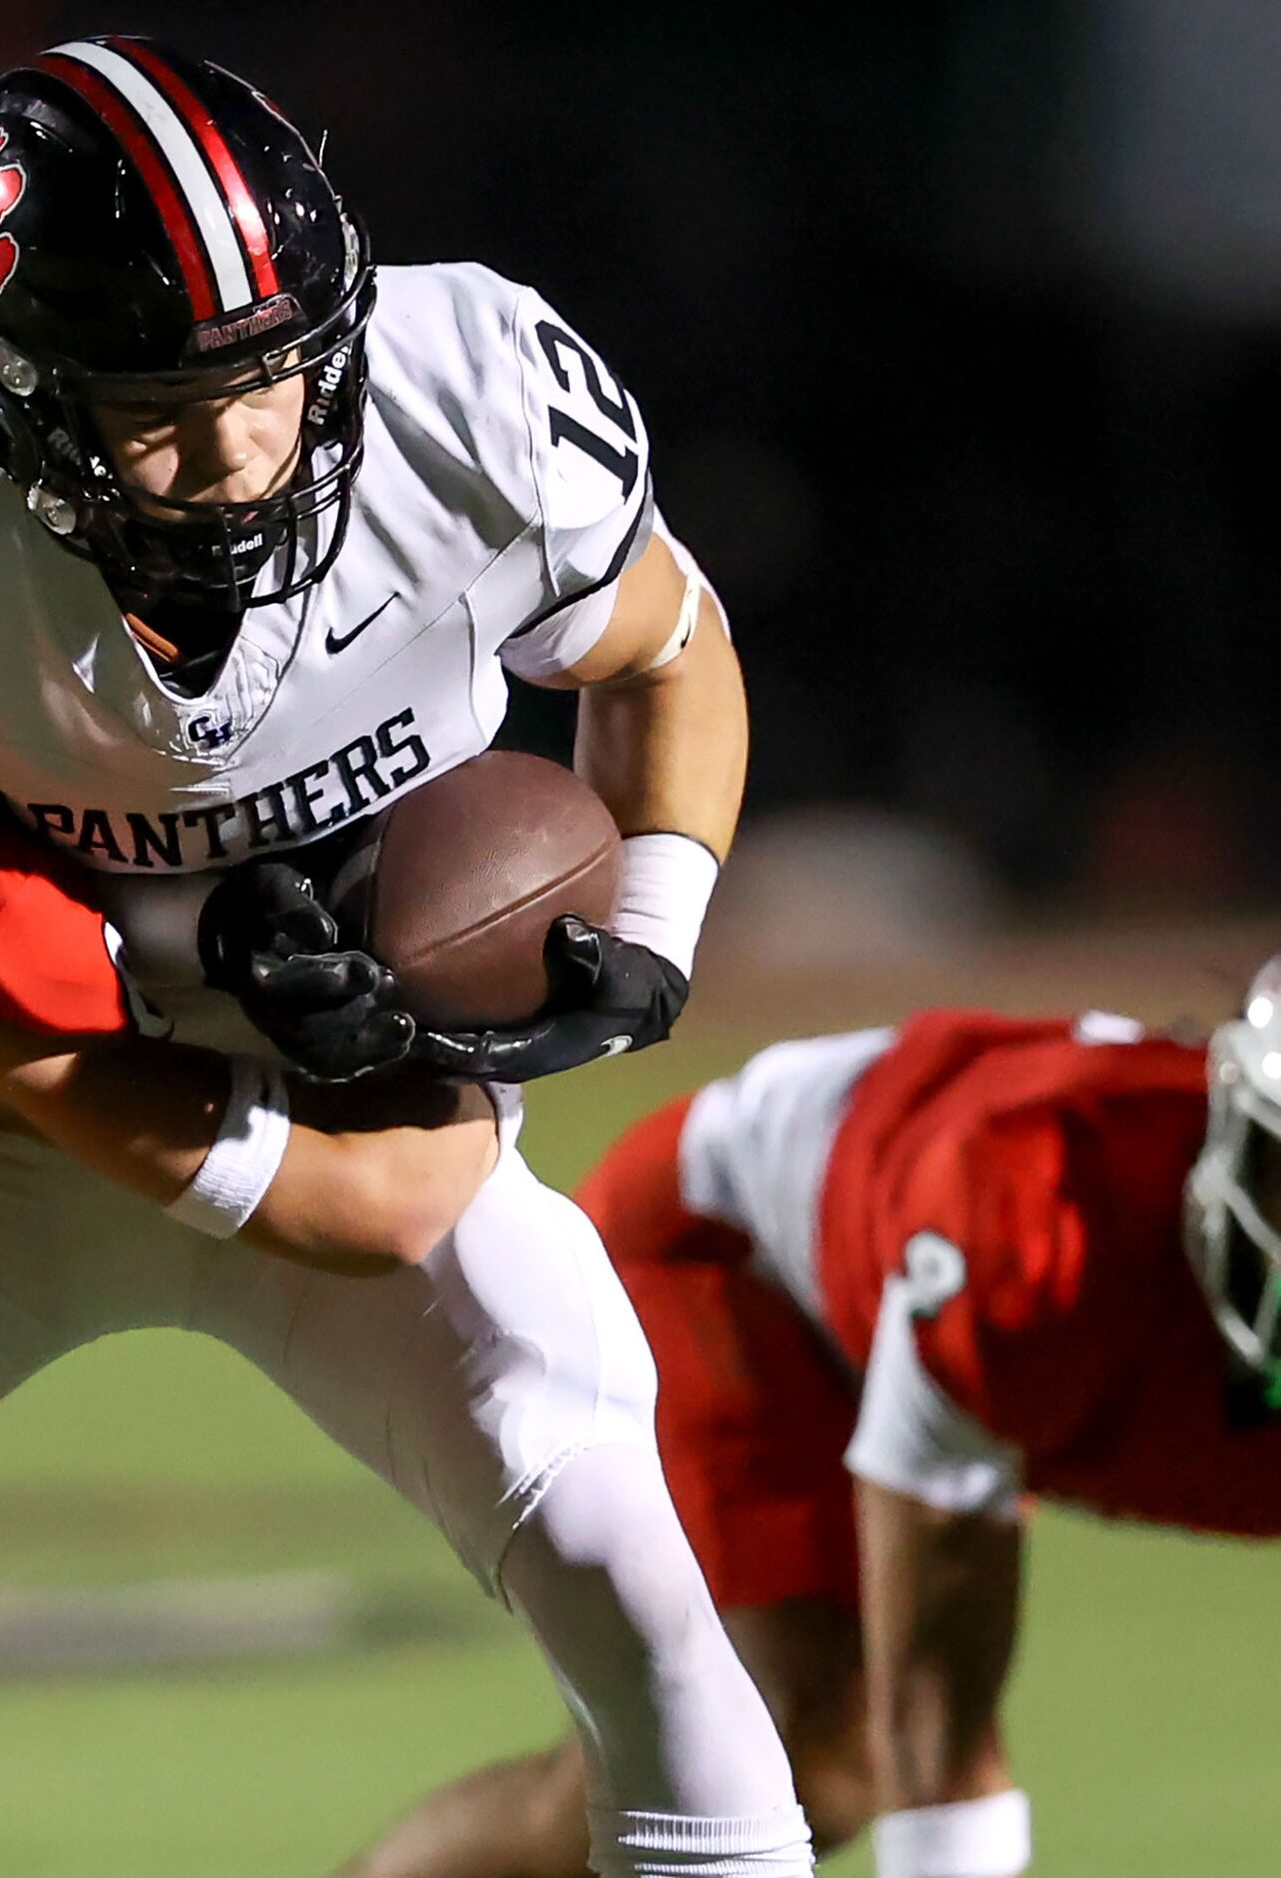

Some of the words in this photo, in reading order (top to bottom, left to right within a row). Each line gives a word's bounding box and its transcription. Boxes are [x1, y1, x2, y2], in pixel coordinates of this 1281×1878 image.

[197, 299, 293, 352] PANTHERS
[534, 319, 639, 506] 12
[26, 707, 432, 868] PANTHERS
